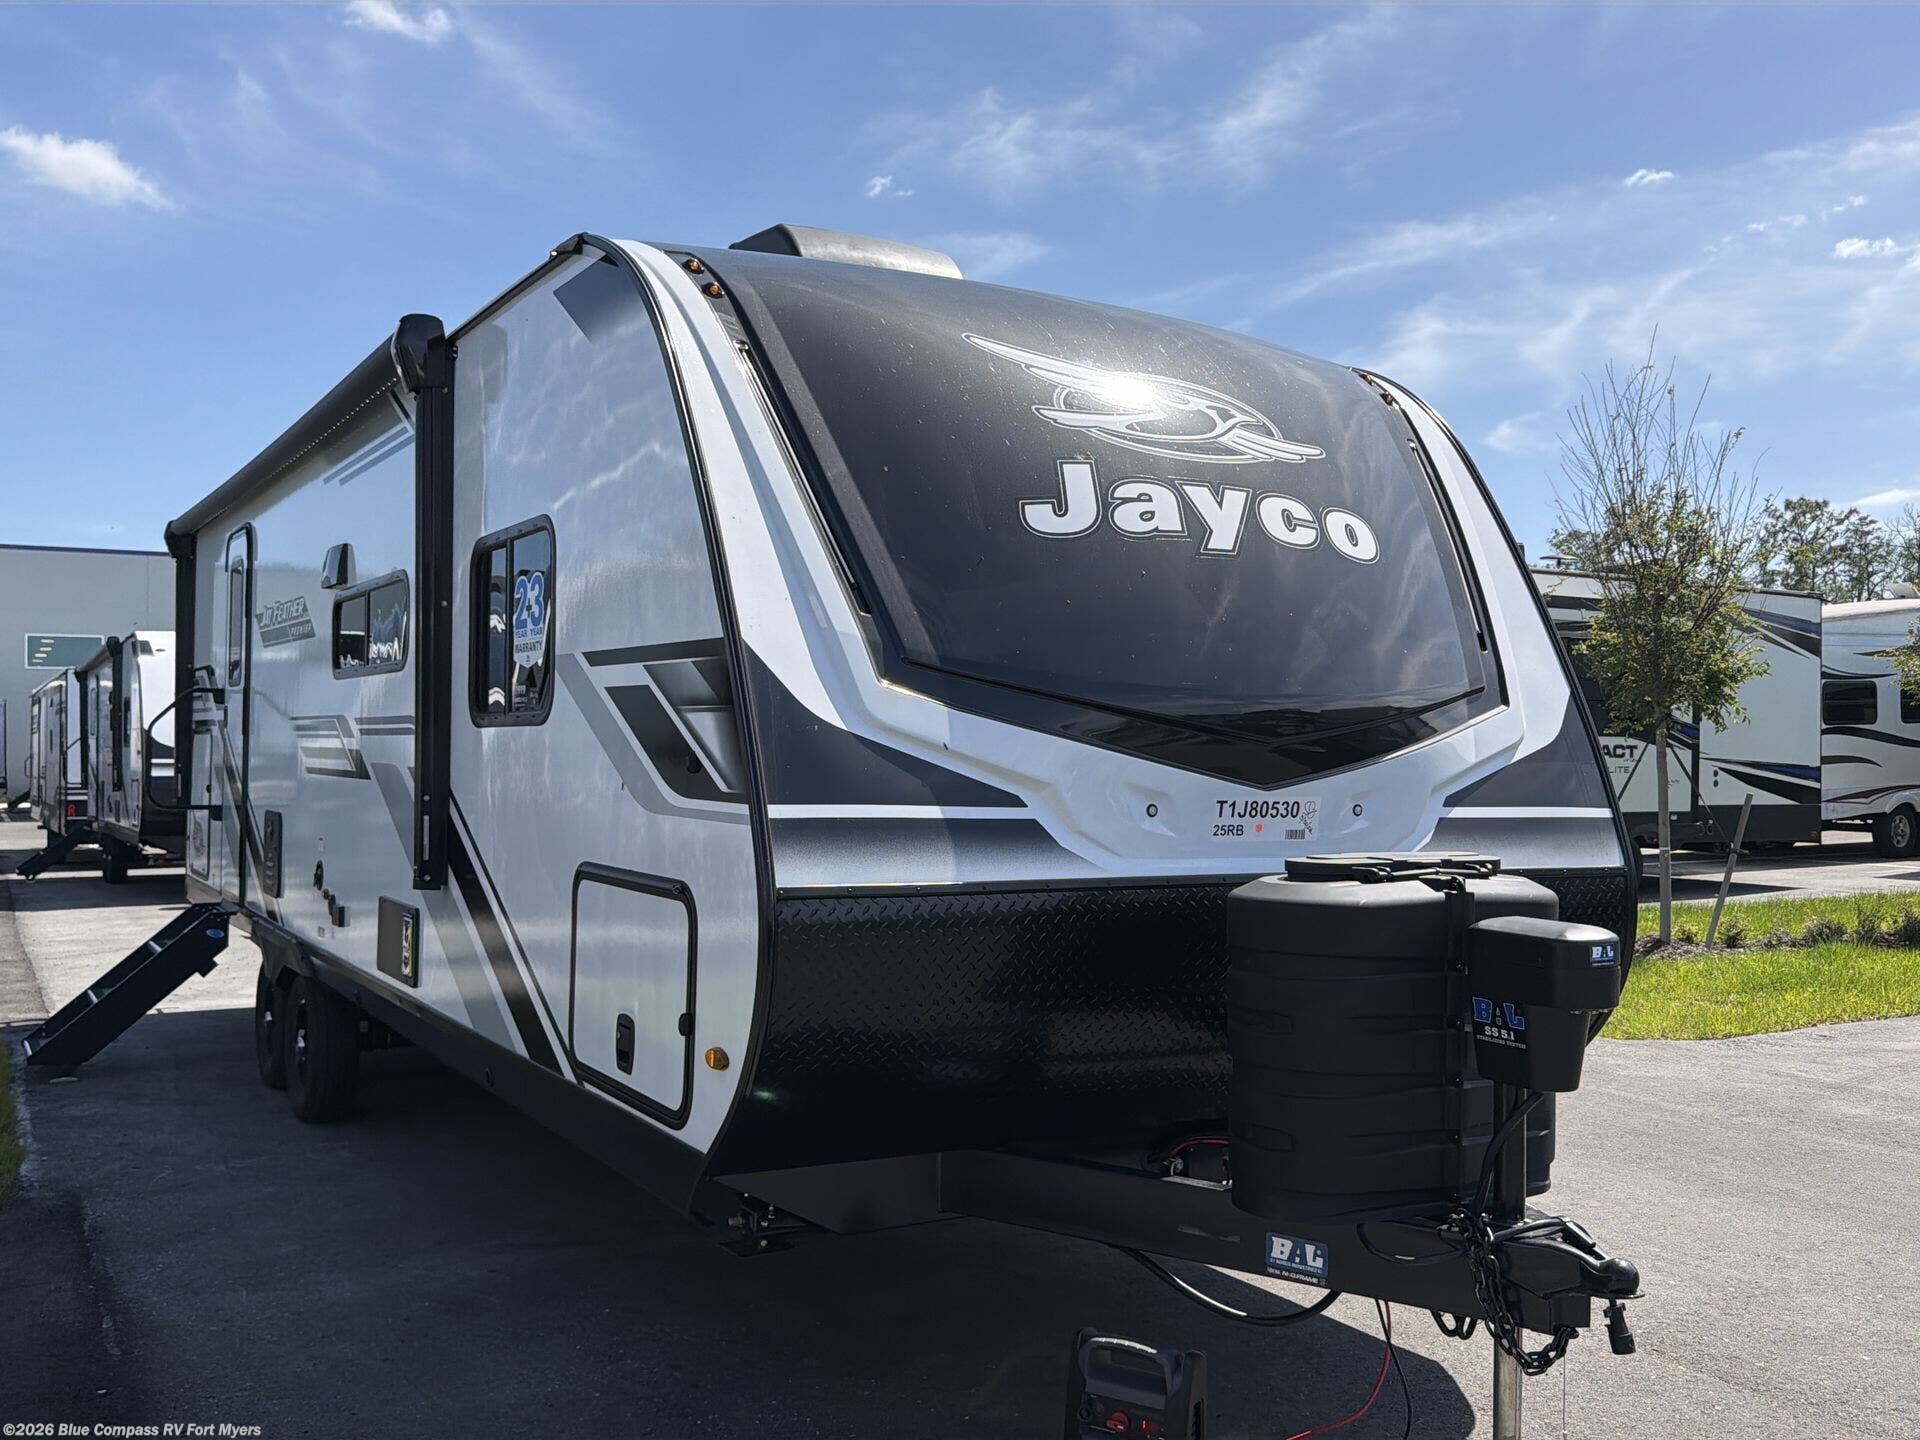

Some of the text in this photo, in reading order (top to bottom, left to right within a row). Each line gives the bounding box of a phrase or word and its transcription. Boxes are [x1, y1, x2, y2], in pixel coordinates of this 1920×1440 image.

[1019, 460, 1380, 564] Jayco
[514, 640, 543, 654] WARRANTY
[1216, 799, 1300, 819] T1J80530
[1212, 824, 1244, 836] 25RB
[1484, 1025, 1515, 1041] SS 5.1
